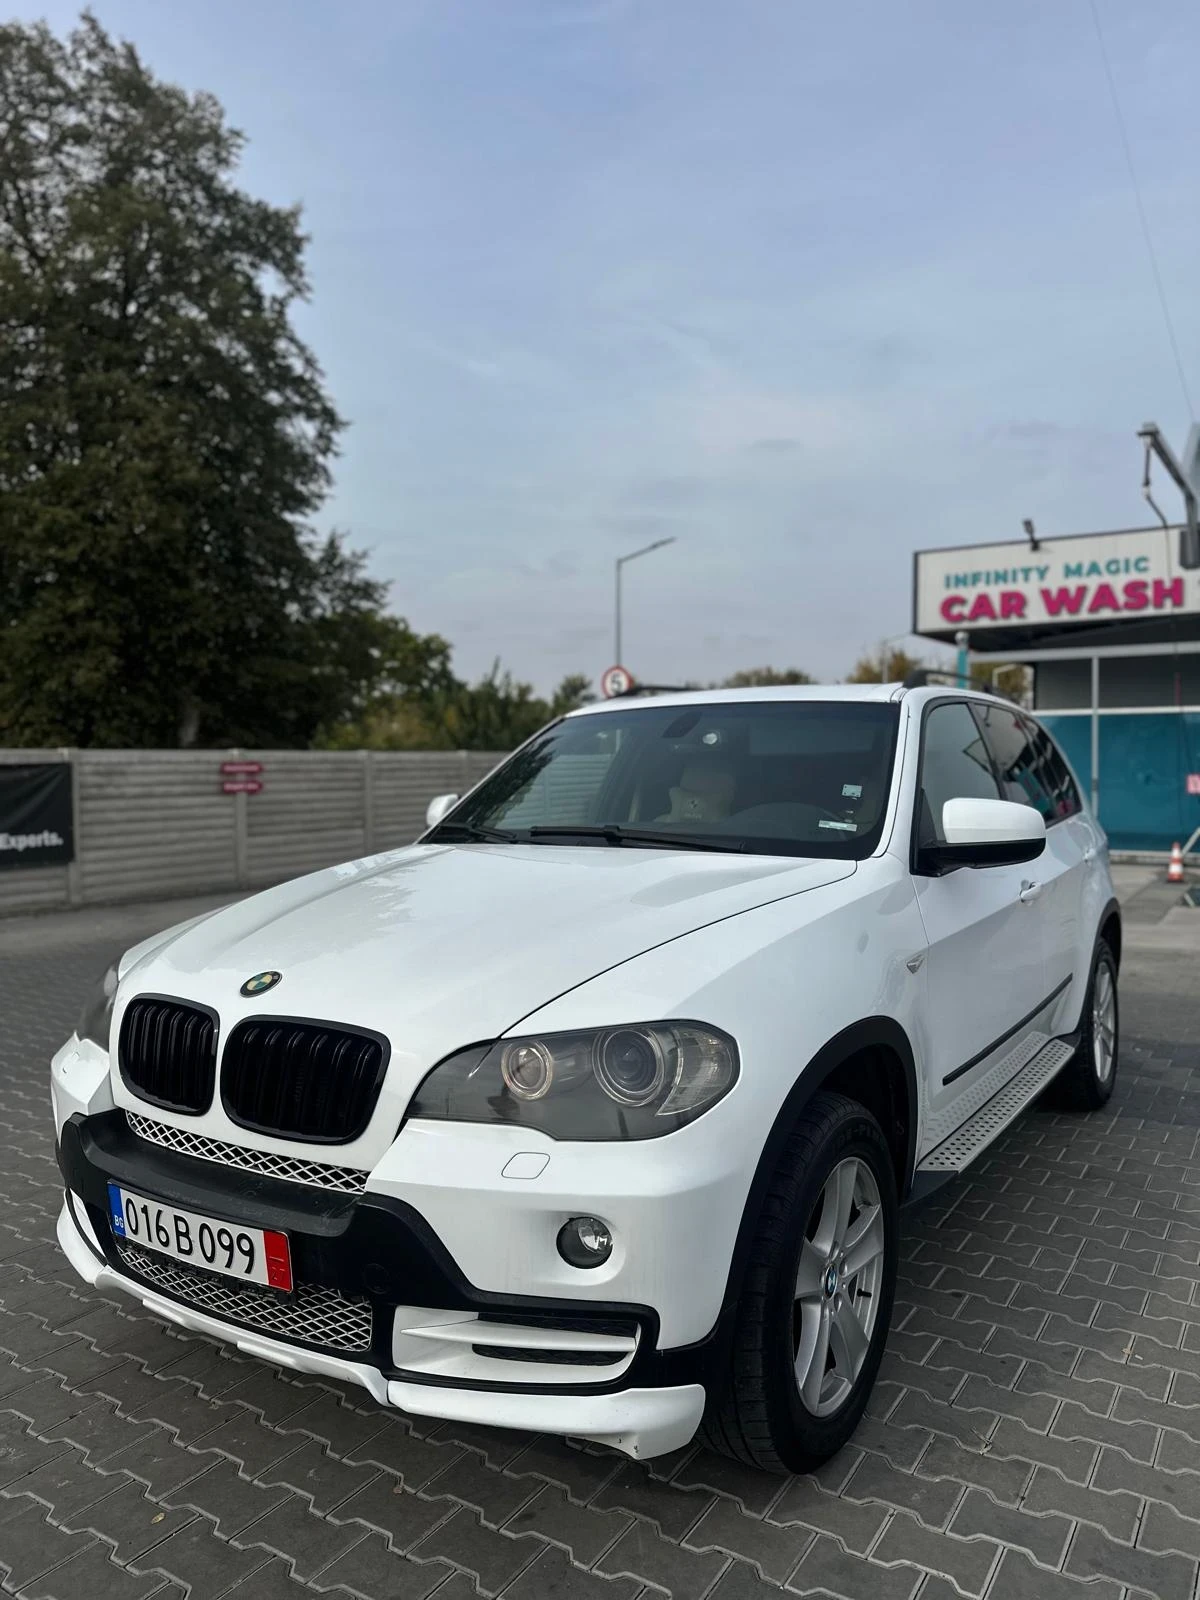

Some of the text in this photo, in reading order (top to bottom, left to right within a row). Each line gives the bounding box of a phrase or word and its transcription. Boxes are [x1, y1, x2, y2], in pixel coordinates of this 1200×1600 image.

[944, 556, 1150, 589] INFINITY MAGIC
[940, 577, 1184, 623] CAR WASH
[610, 673, 622, 693] 5
[114, 1215, 124, 1228] BG
